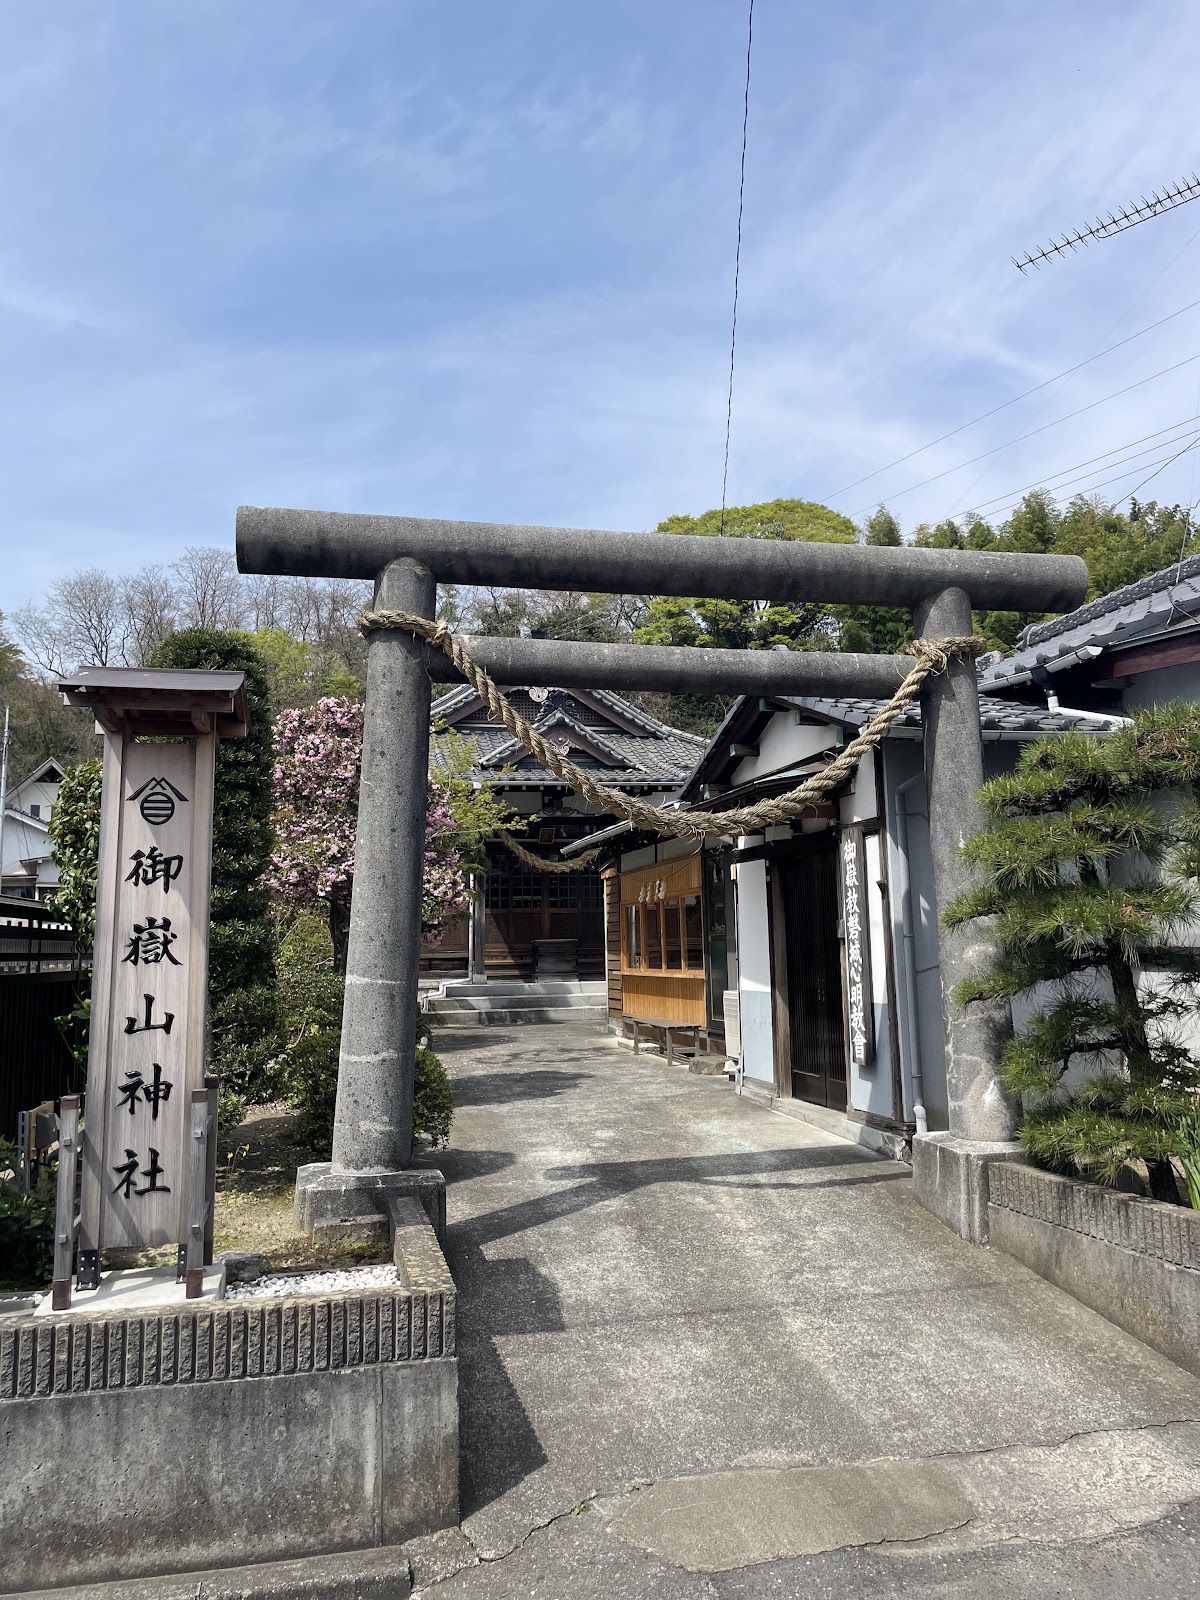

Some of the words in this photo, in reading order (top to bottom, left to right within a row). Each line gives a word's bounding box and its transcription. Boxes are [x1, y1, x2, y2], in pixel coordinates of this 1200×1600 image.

[111, 845, 184, 1200] 御嶽山神社
